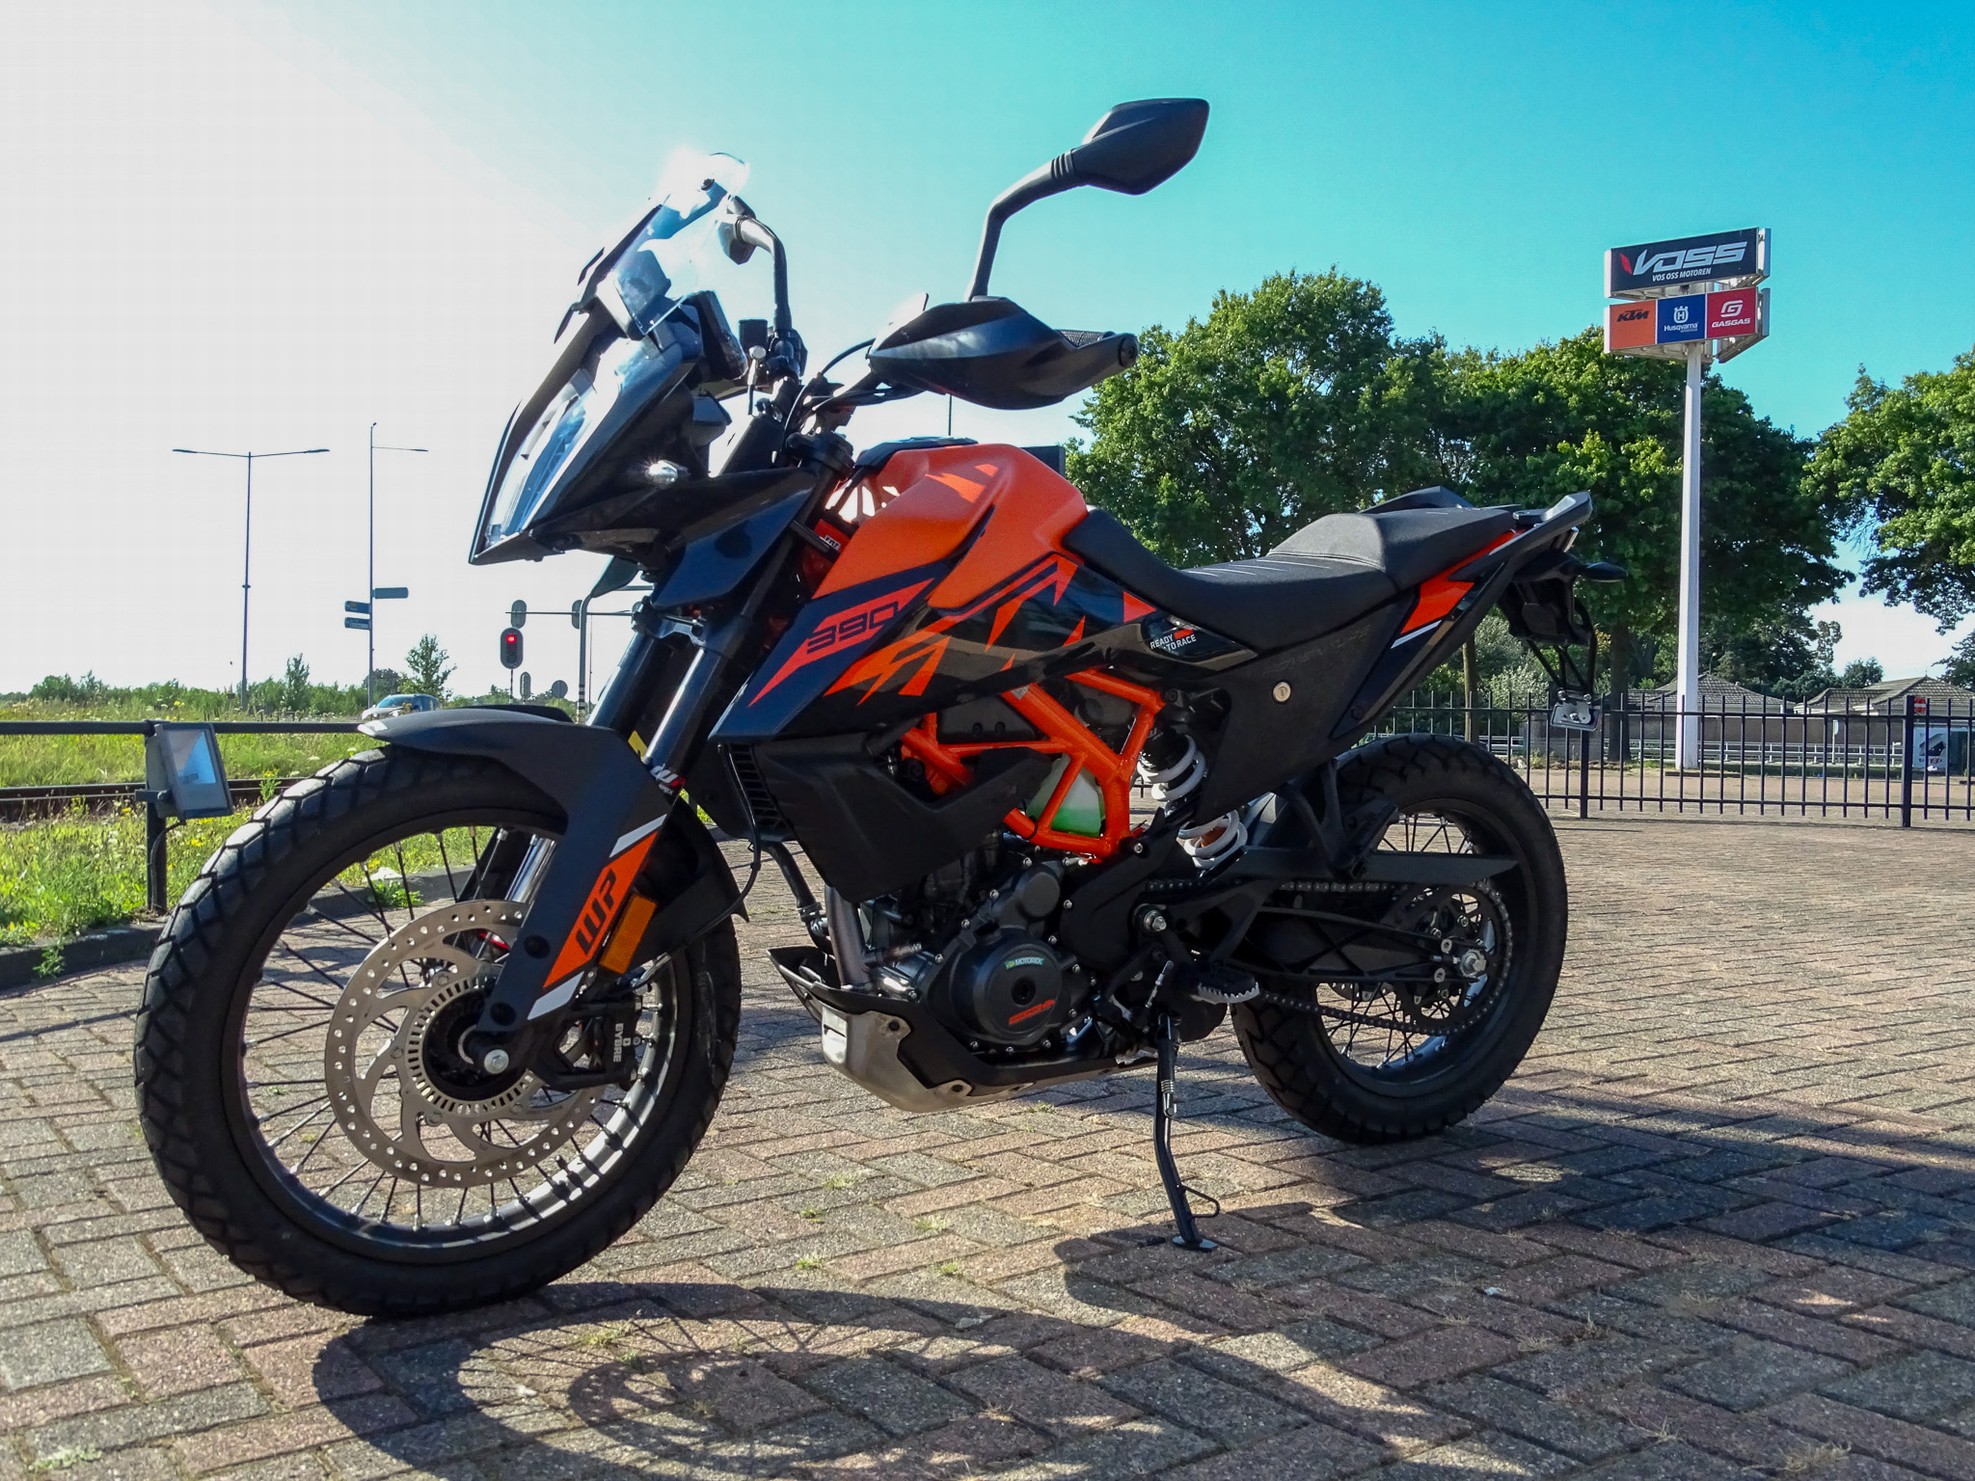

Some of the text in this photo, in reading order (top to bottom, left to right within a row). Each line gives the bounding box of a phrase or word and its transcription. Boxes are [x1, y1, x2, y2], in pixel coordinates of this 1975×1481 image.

[1632, 241, 1748, 276] VOSS
[1652, 267, 1712, 282] VOS OSS MOTOREN
[1617, 309, 1650, 322] KTM
[1712, 318, 1751, 328] GASGAS
[1664, 322, 1698, 332] Husqvarna
[806, 601, 899, 653] 390
[1150, 634, 1173, 649] READY
[1166, 634, 1197, 651] TO RACE
[575, 868, 617, 956] WP
[613, 1023, 624, 1062] BYBRE
